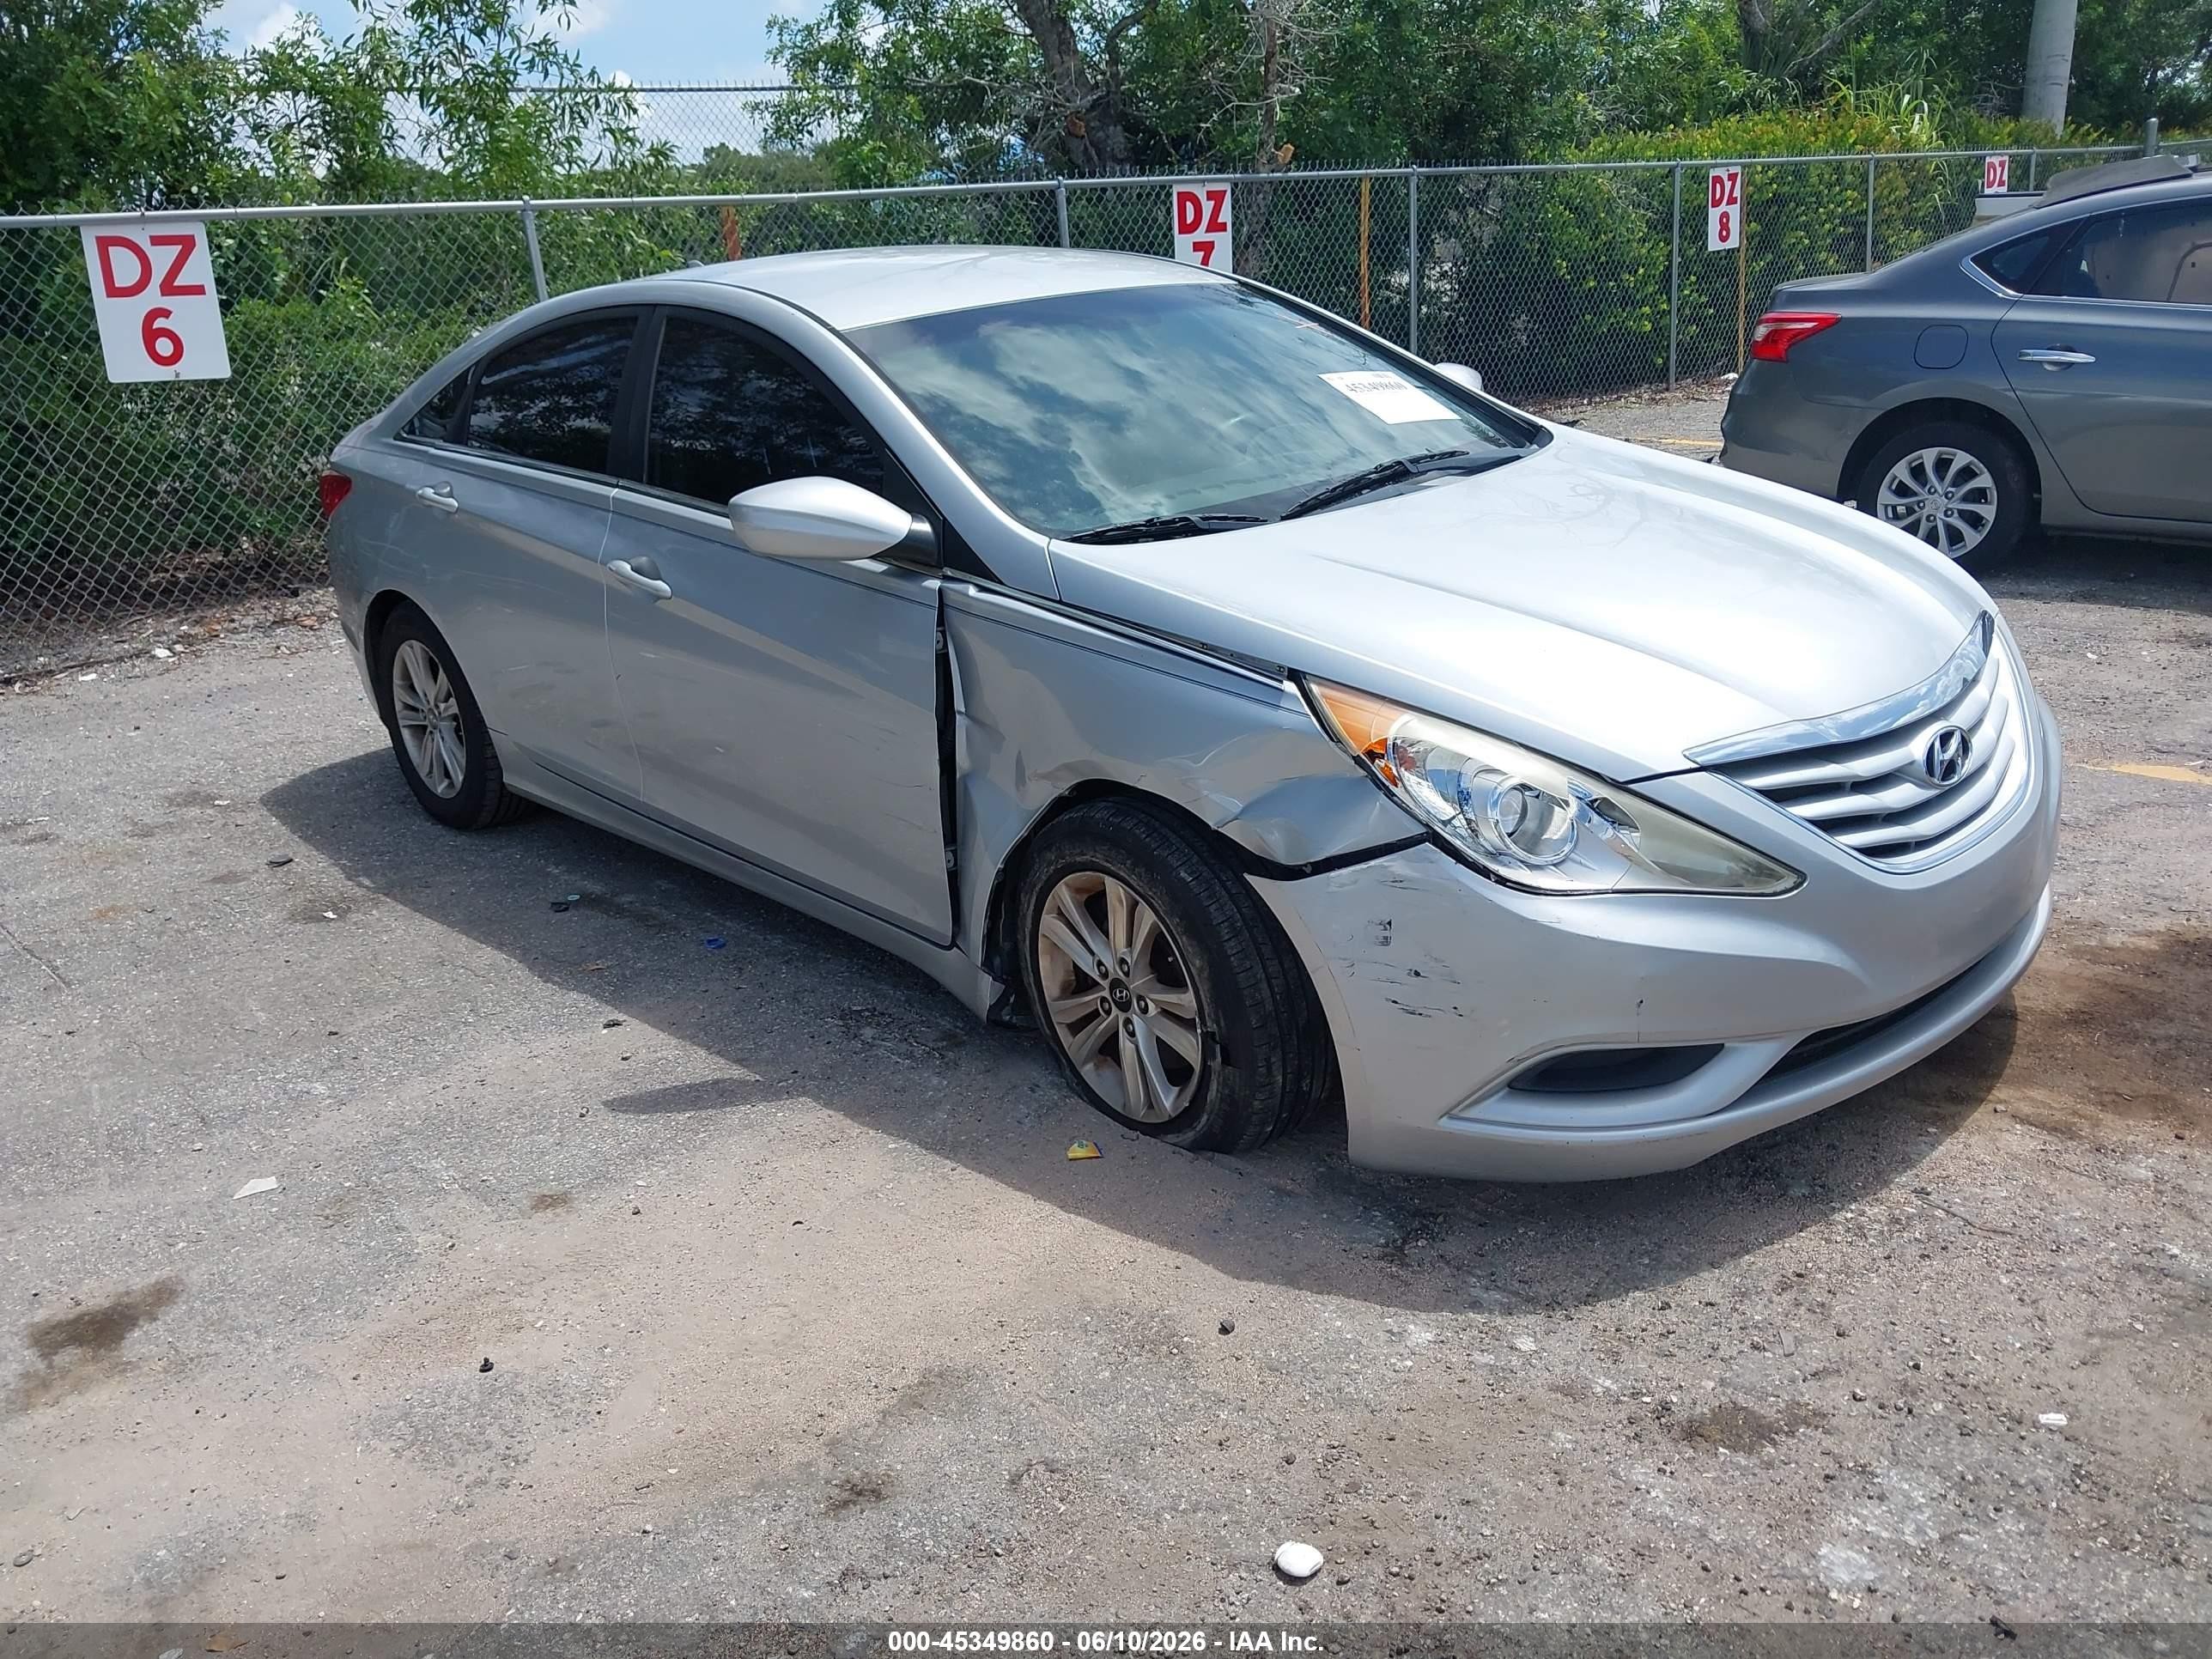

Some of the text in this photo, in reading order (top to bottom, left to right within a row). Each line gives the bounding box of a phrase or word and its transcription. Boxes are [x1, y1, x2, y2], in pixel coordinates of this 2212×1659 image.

[1711, 172, 1739, 208] DZ
[1986, 160, 2007, 189] DZ
[1176, 190, 1228, 235] DZ
[1718, 210, 1730, 243] 8
[95, 234, 206, 298] DZ
[1192, 240, 1215, 267] 7
[142, 307, 185, 367] 6
